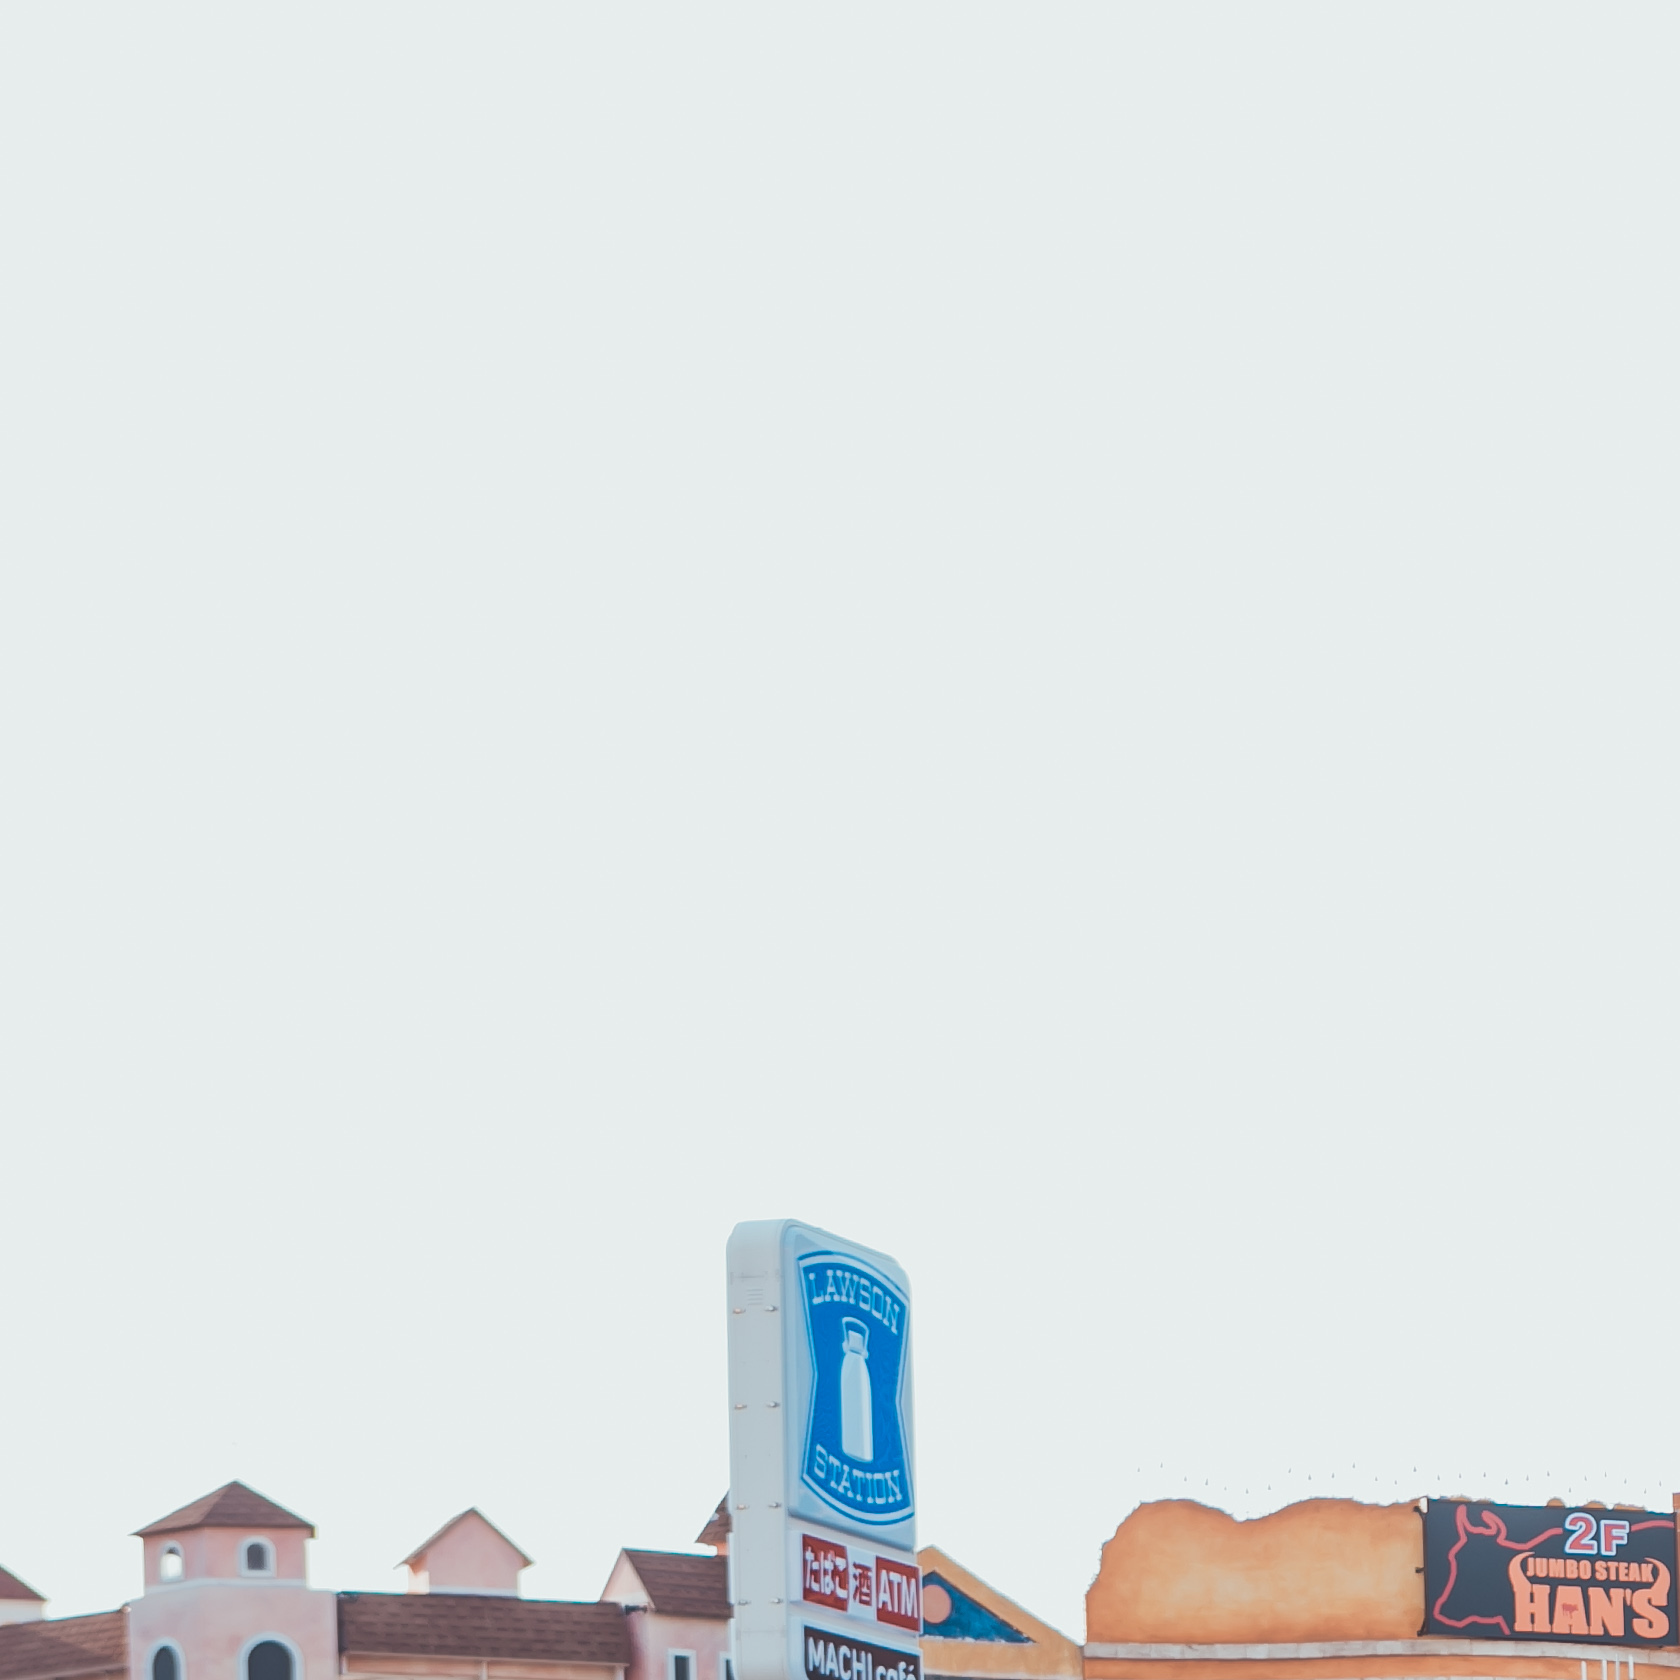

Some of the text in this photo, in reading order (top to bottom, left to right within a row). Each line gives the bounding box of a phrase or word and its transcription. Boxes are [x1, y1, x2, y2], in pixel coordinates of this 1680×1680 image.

[808, 1269, 901, 1335] LAWSON
[813, 1444, 902, 1504] STATION
[1565, 1512, 1630, 1556] 2F
[804, 1544, 919, 1619] たばこ 酒 ATM
[1526, 1557, 1655, 1583] JUMBO STEAK
[1513, 1579, 1670, 1639] HAN'S
